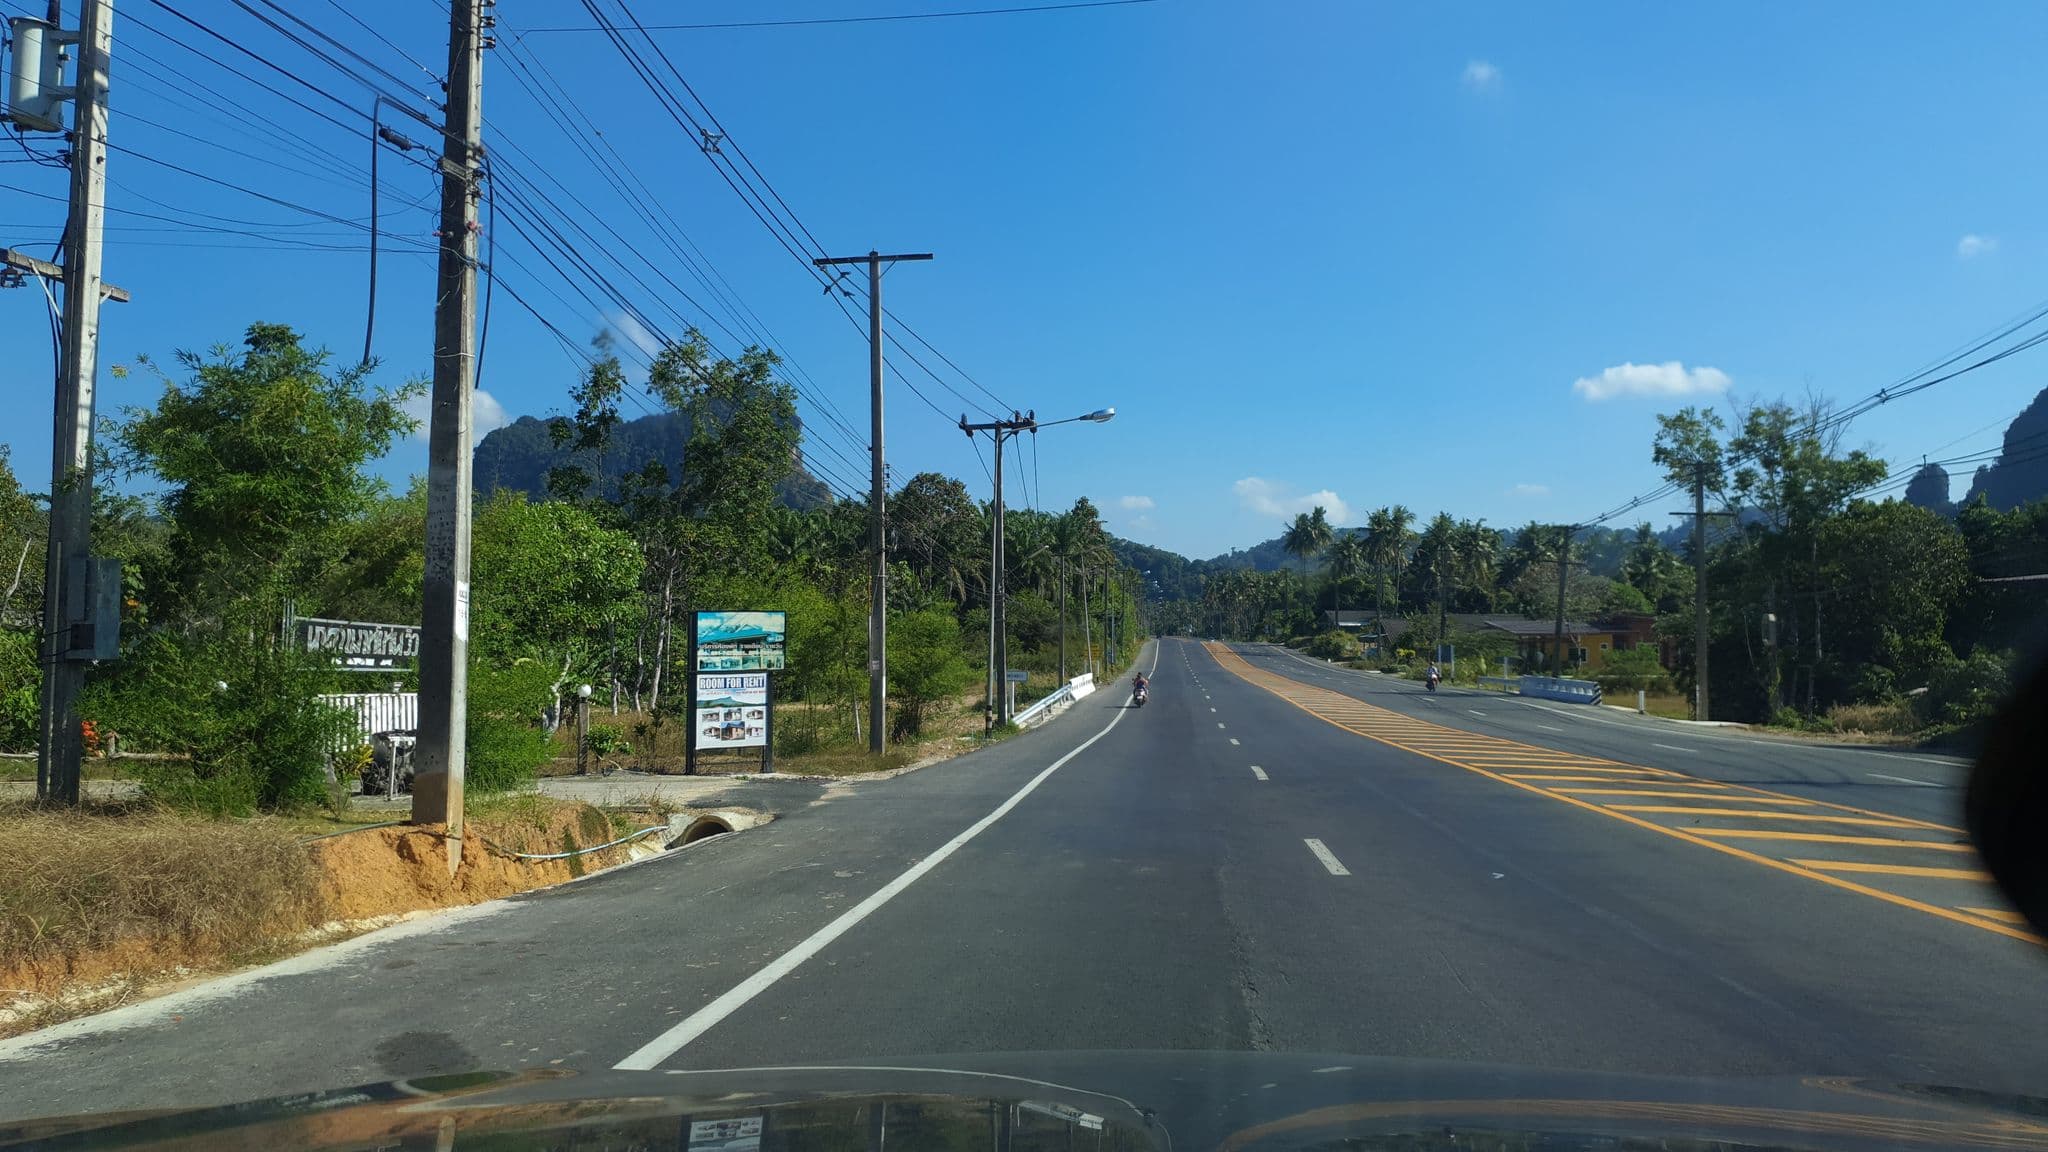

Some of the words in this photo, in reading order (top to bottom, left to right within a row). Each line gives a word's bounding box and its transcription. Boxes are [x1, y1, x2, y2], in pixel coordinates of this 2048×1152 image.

[700, 678, 724, 689] ROOM
[726, 677, 742, 688] FOR
[743, 677, 764, 688] RENT
